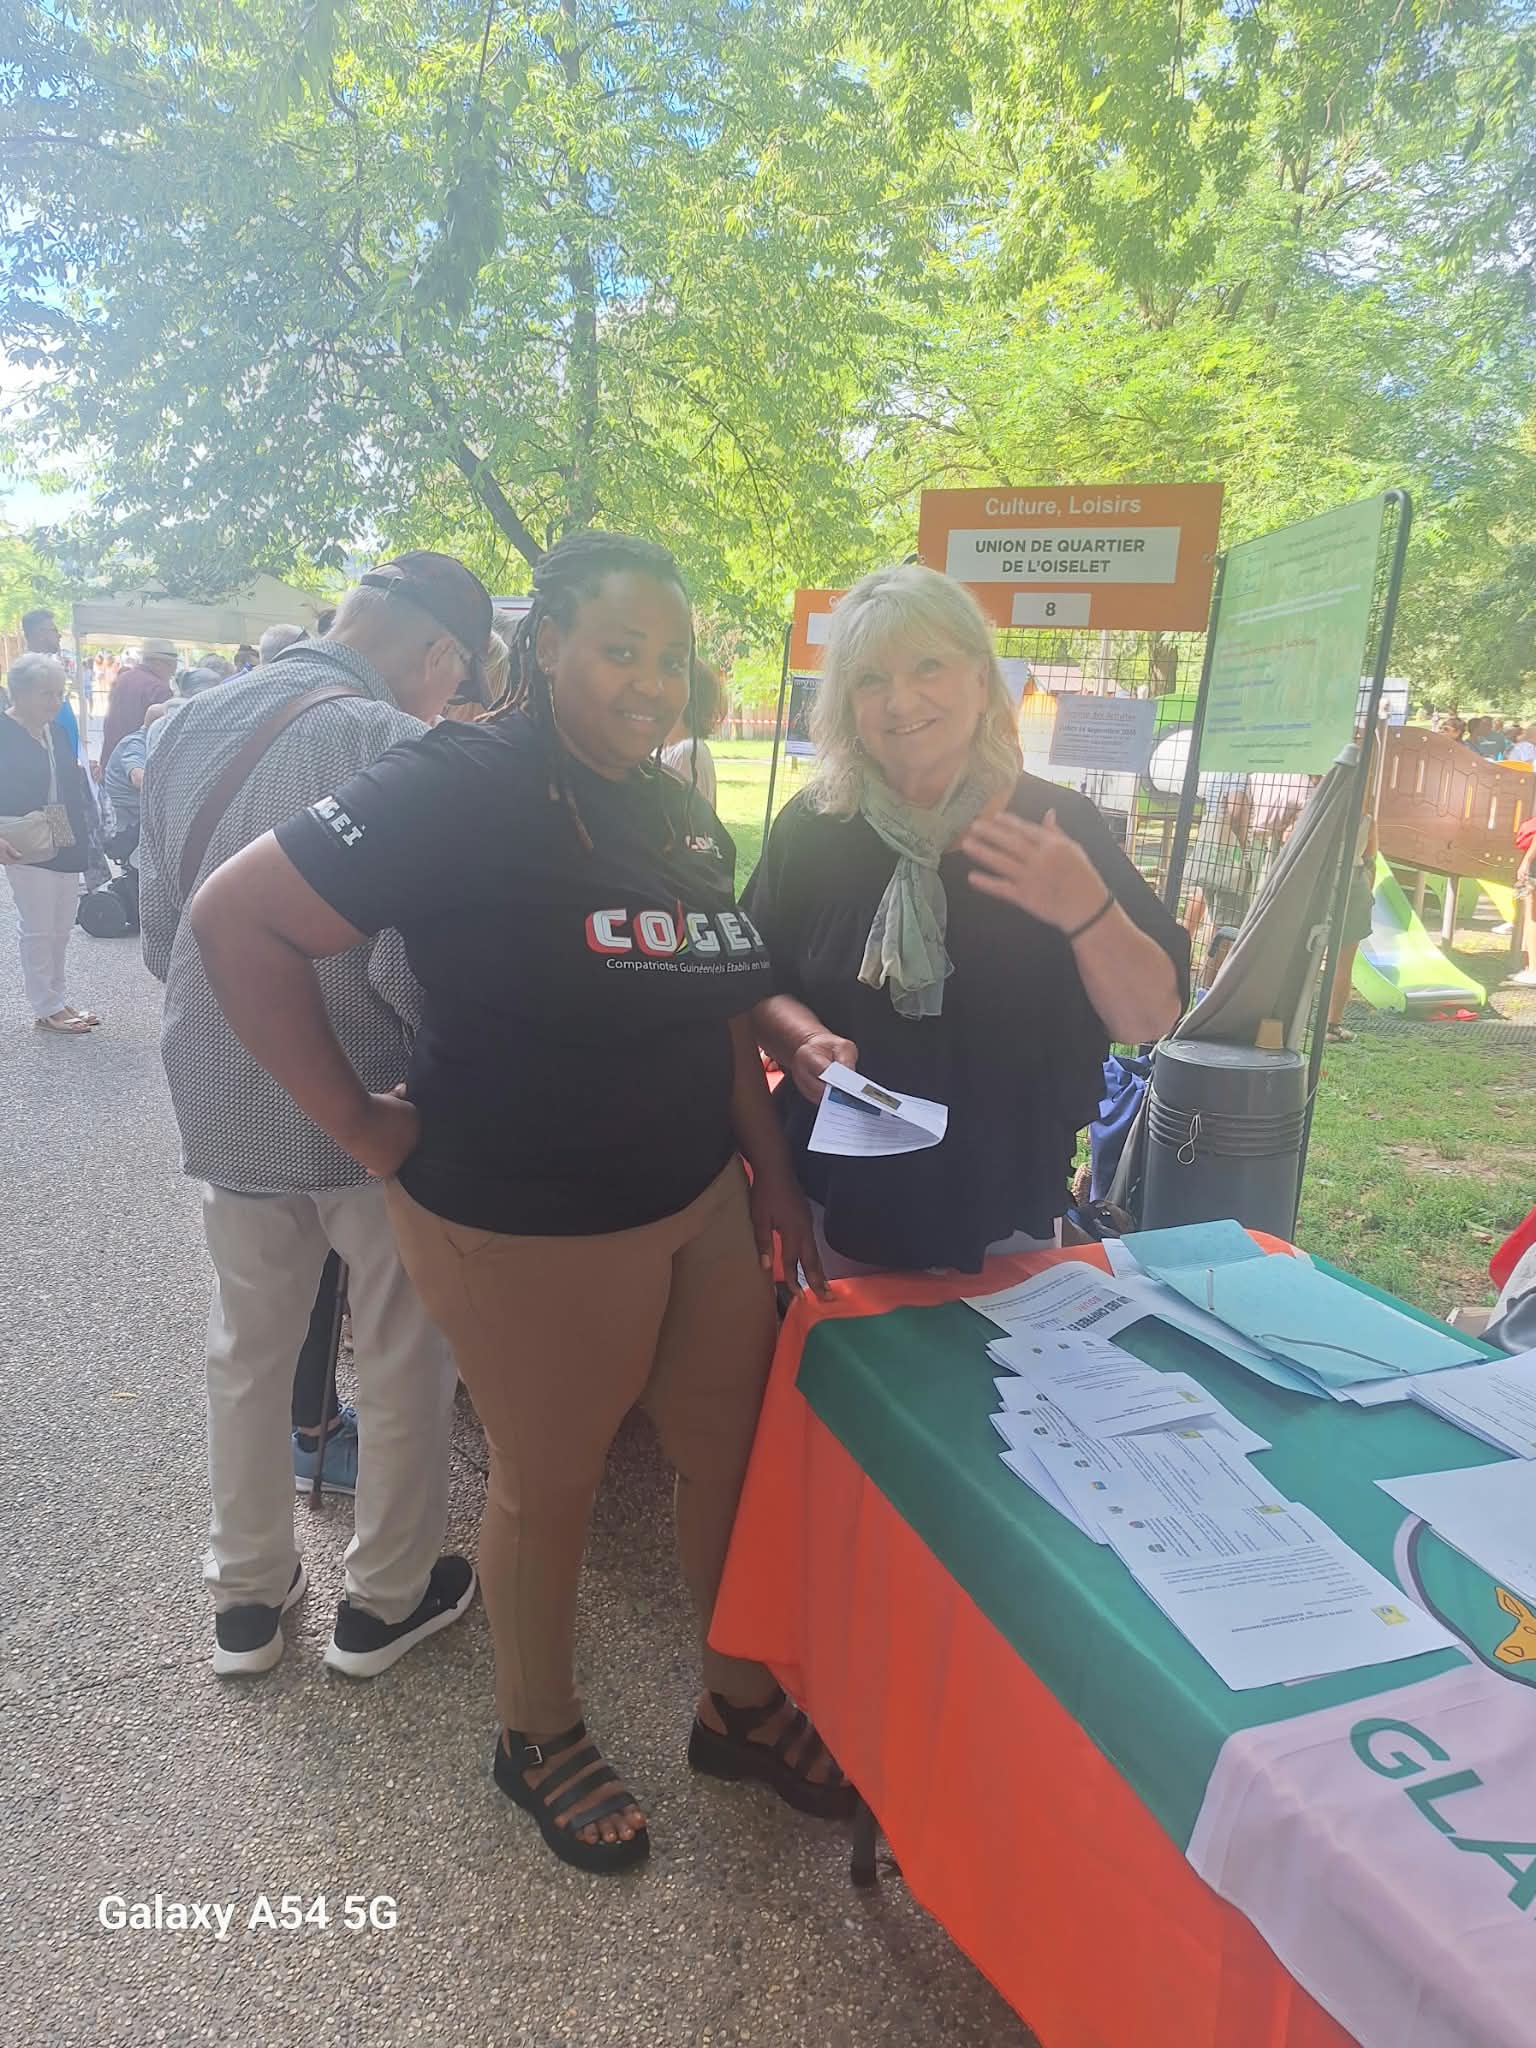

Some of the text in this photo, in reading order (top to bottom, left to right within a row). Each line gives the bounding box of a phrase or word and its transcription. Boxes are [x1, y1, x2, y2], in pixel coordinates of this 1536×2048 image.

[984, 496, 1142, 517] Culture, Loisirs
[975, 539, 1145, 553] UNION DE QUARTIER
[1002, 560, 1023, 573] DE
[1045, 602, 1056, 617] 8
[606, 958, 679, 973] Compatriotes
